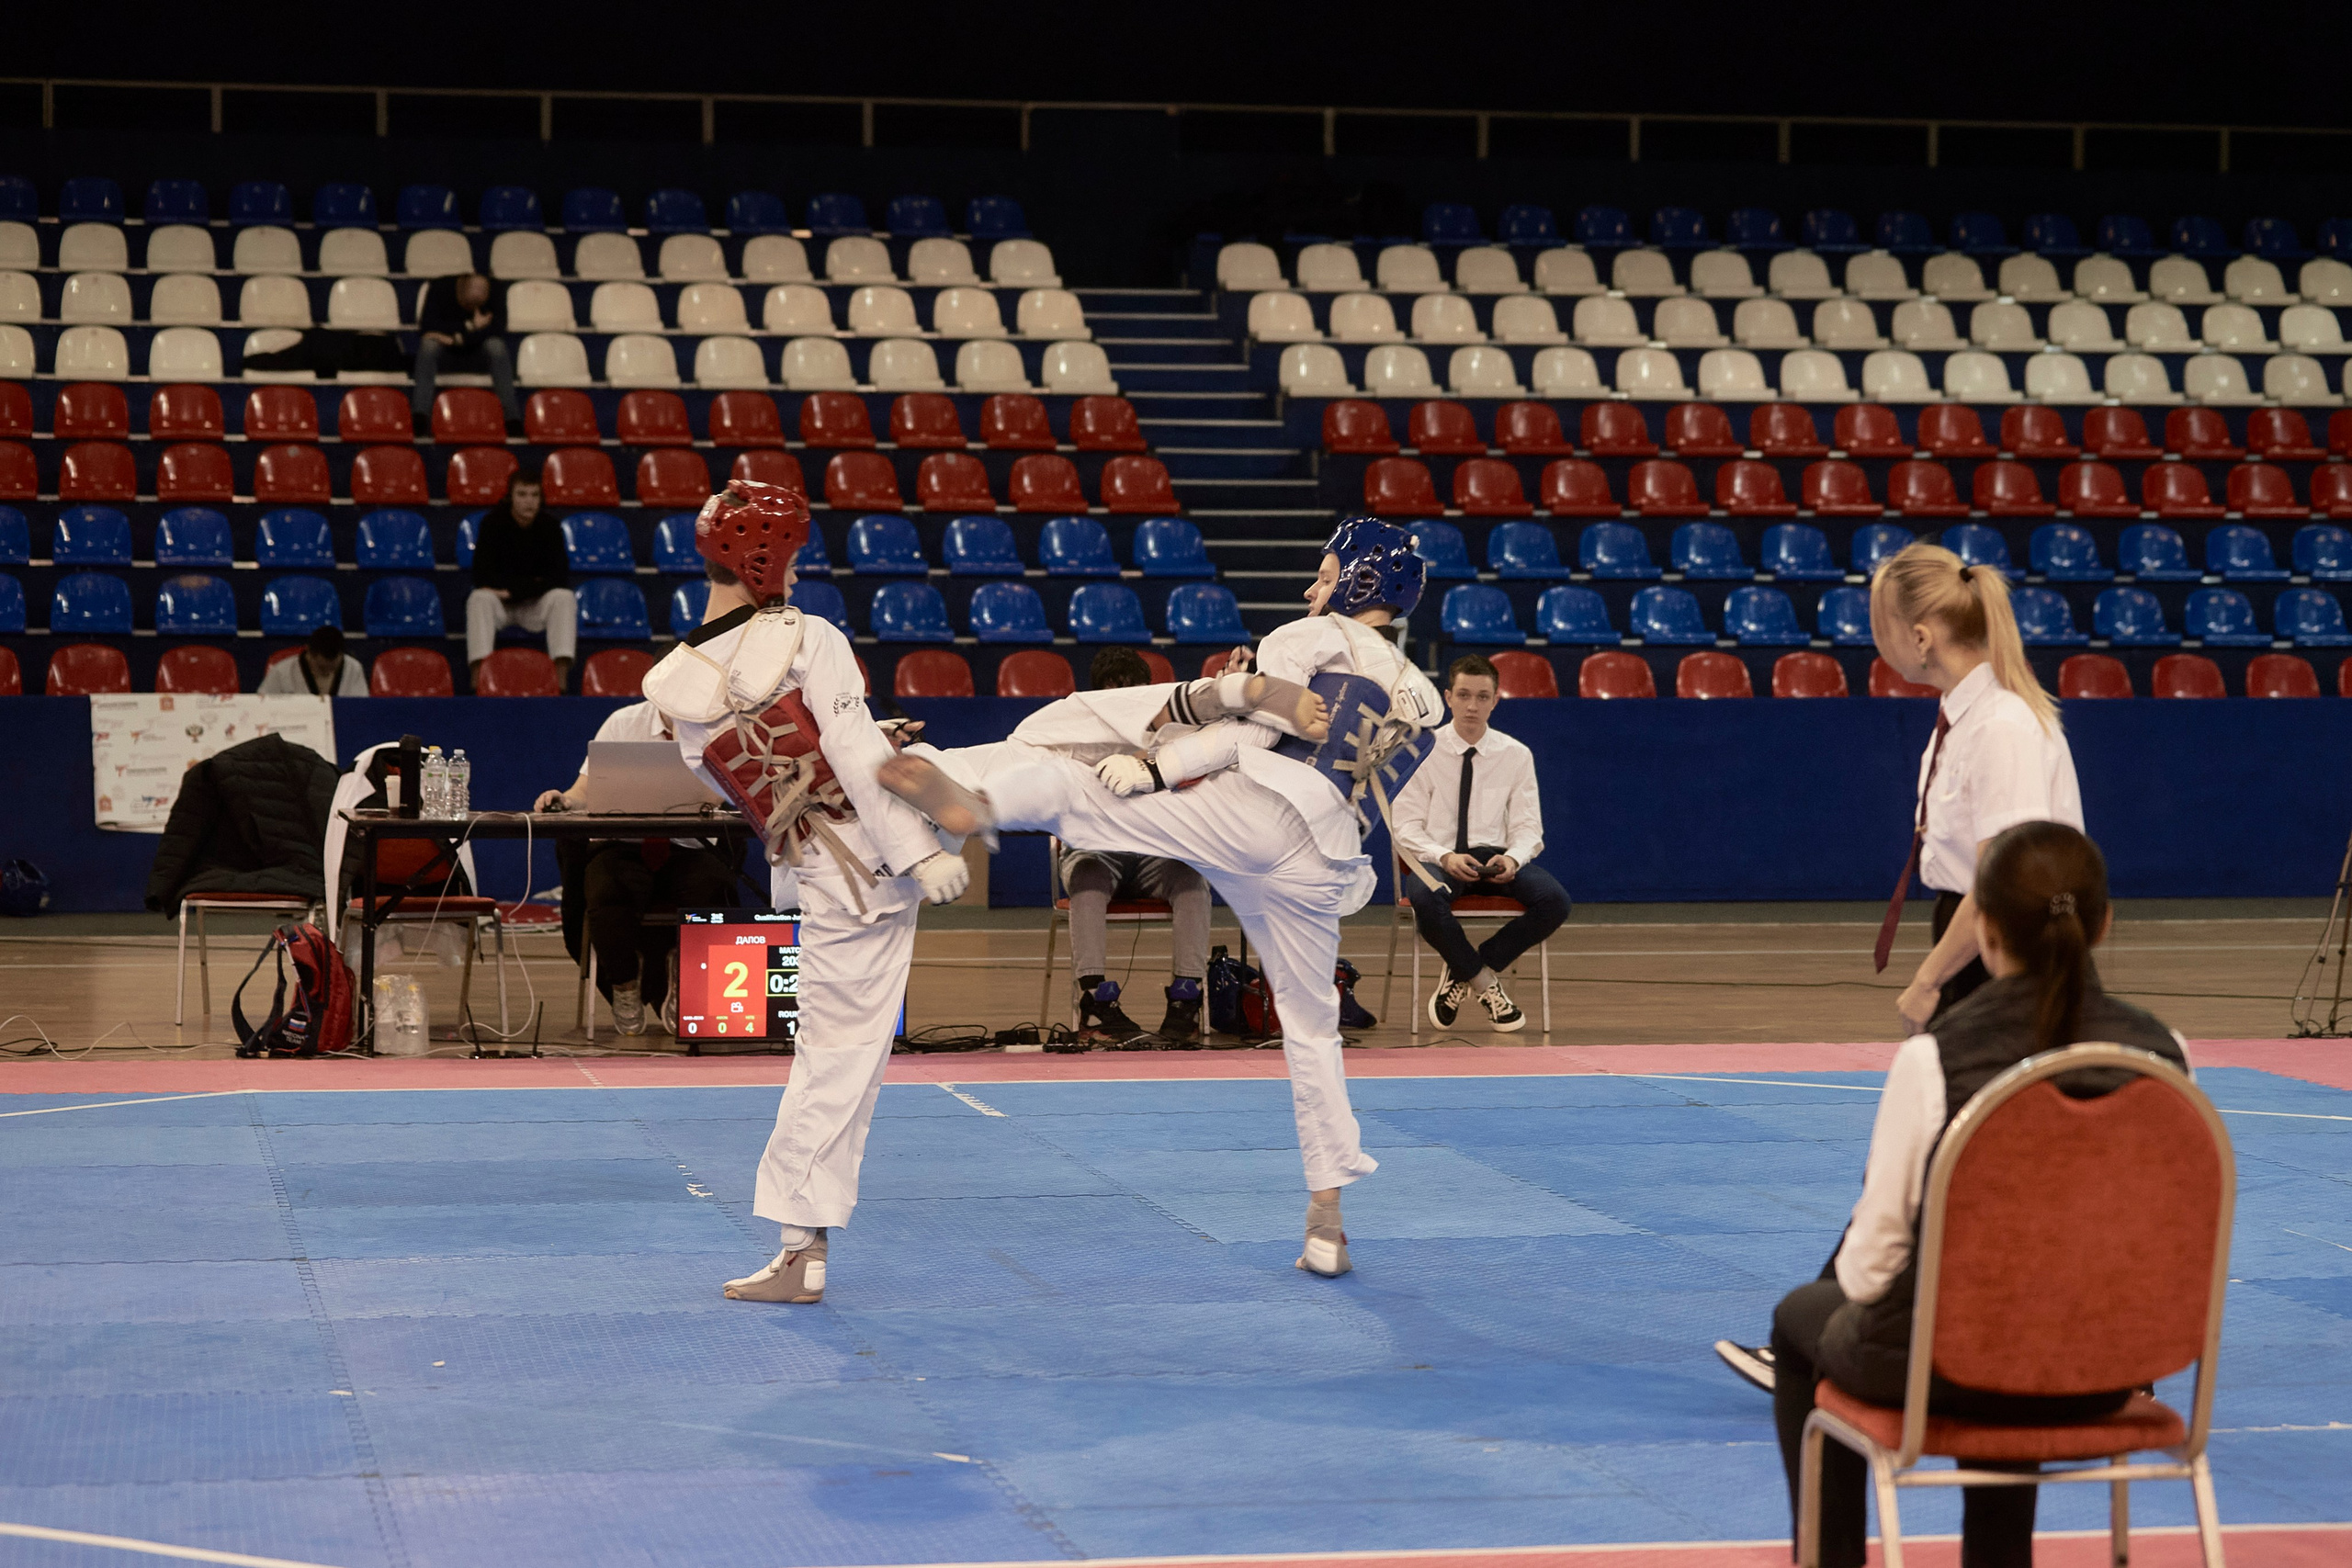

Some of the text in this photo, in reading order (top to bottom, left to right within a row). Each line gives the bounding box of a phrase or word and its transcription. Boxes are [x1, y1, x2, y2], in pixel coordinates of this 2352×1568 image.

[723, 962, 749, 998] 2
[770, 974, 798, 993] 0:2
[688, 1022, 697, 1034] 0
[718, 1022, 727, 1034] 0
[745, 1021, 754, 1033] 4
[786, 1021, 795, 1035] 1
